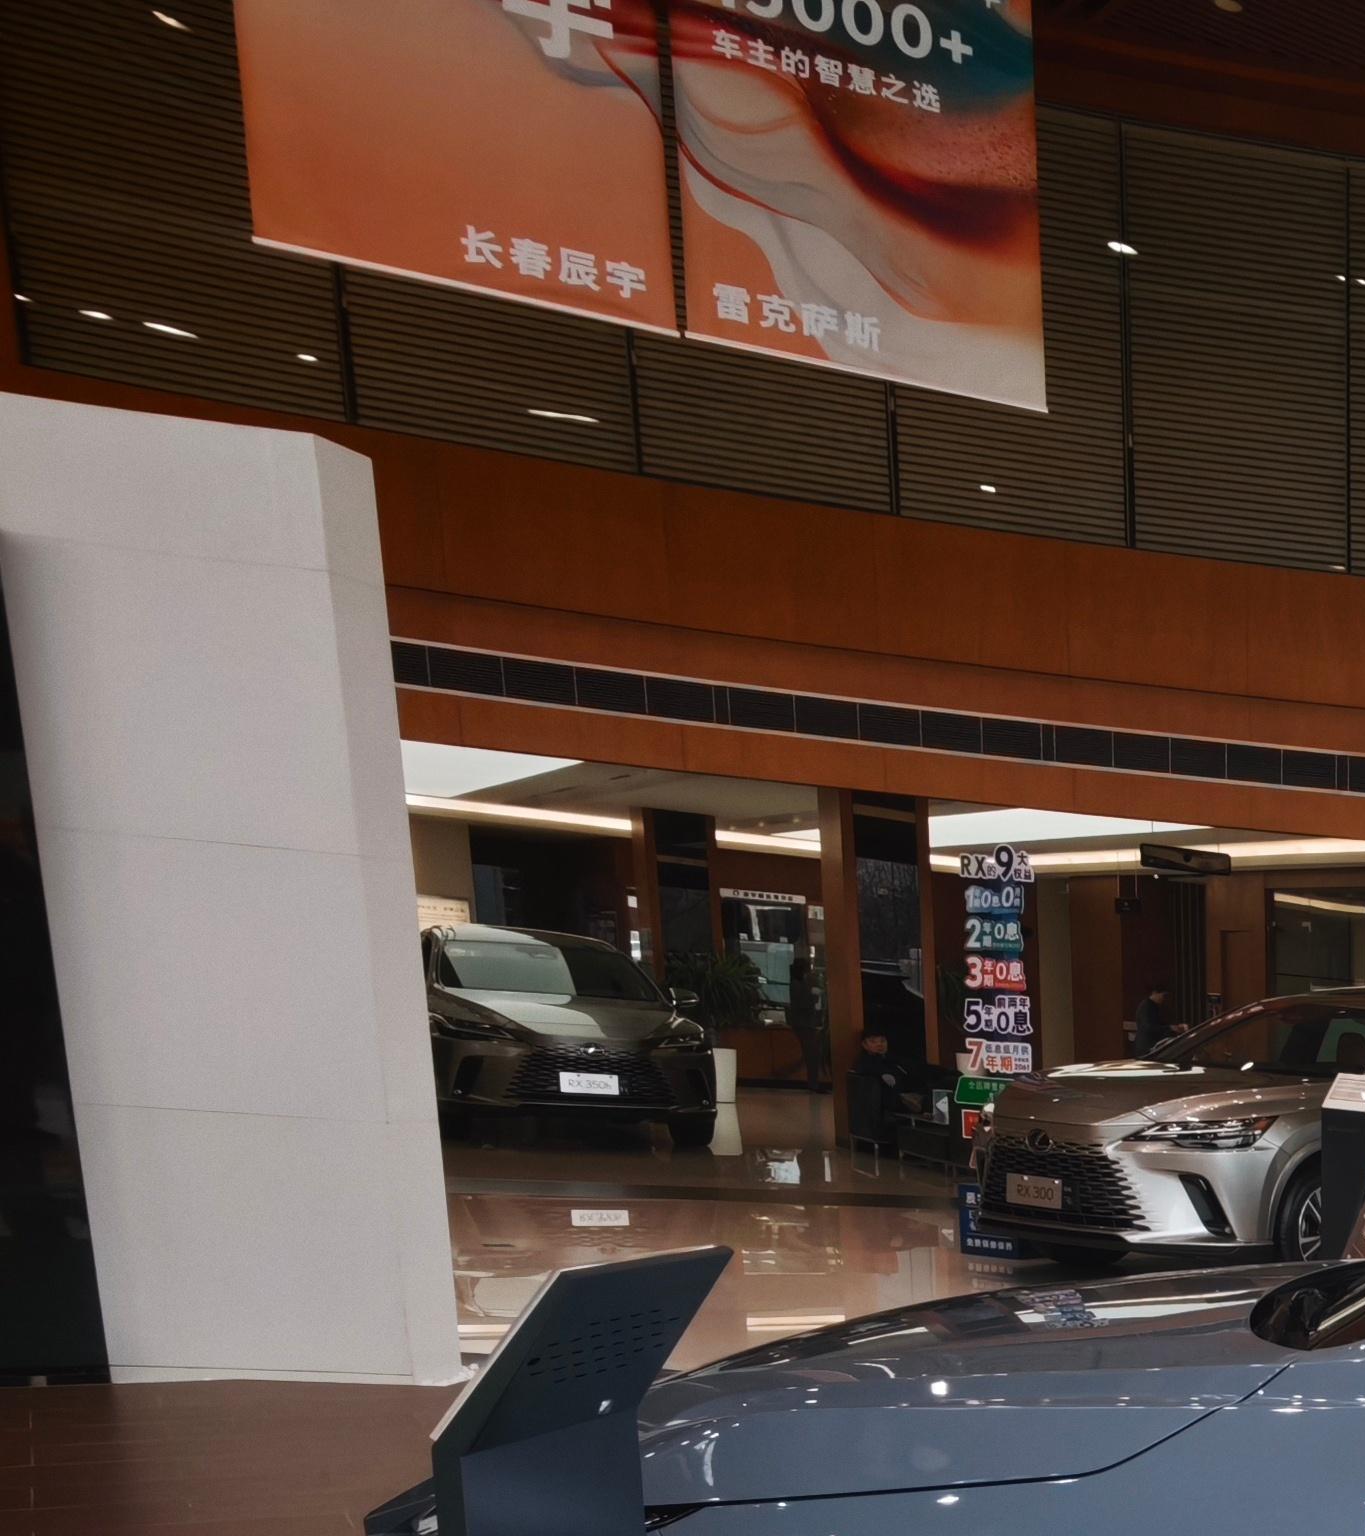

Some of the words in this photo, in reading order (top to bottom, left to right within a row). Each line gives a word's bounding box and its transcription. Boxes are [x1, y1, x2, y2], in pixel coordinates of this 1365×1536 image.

[722, 0, 974, 64] 000+
[711, 28, 942, 115] 车主的智慧之选
[460, 225, 647, 299] 长春辰宇
[712, 283, 882, 352] 雷克萨斯
[1017, 1184, 1031, 1198] RX
[1032, 1186, 1055, 1201] 300
